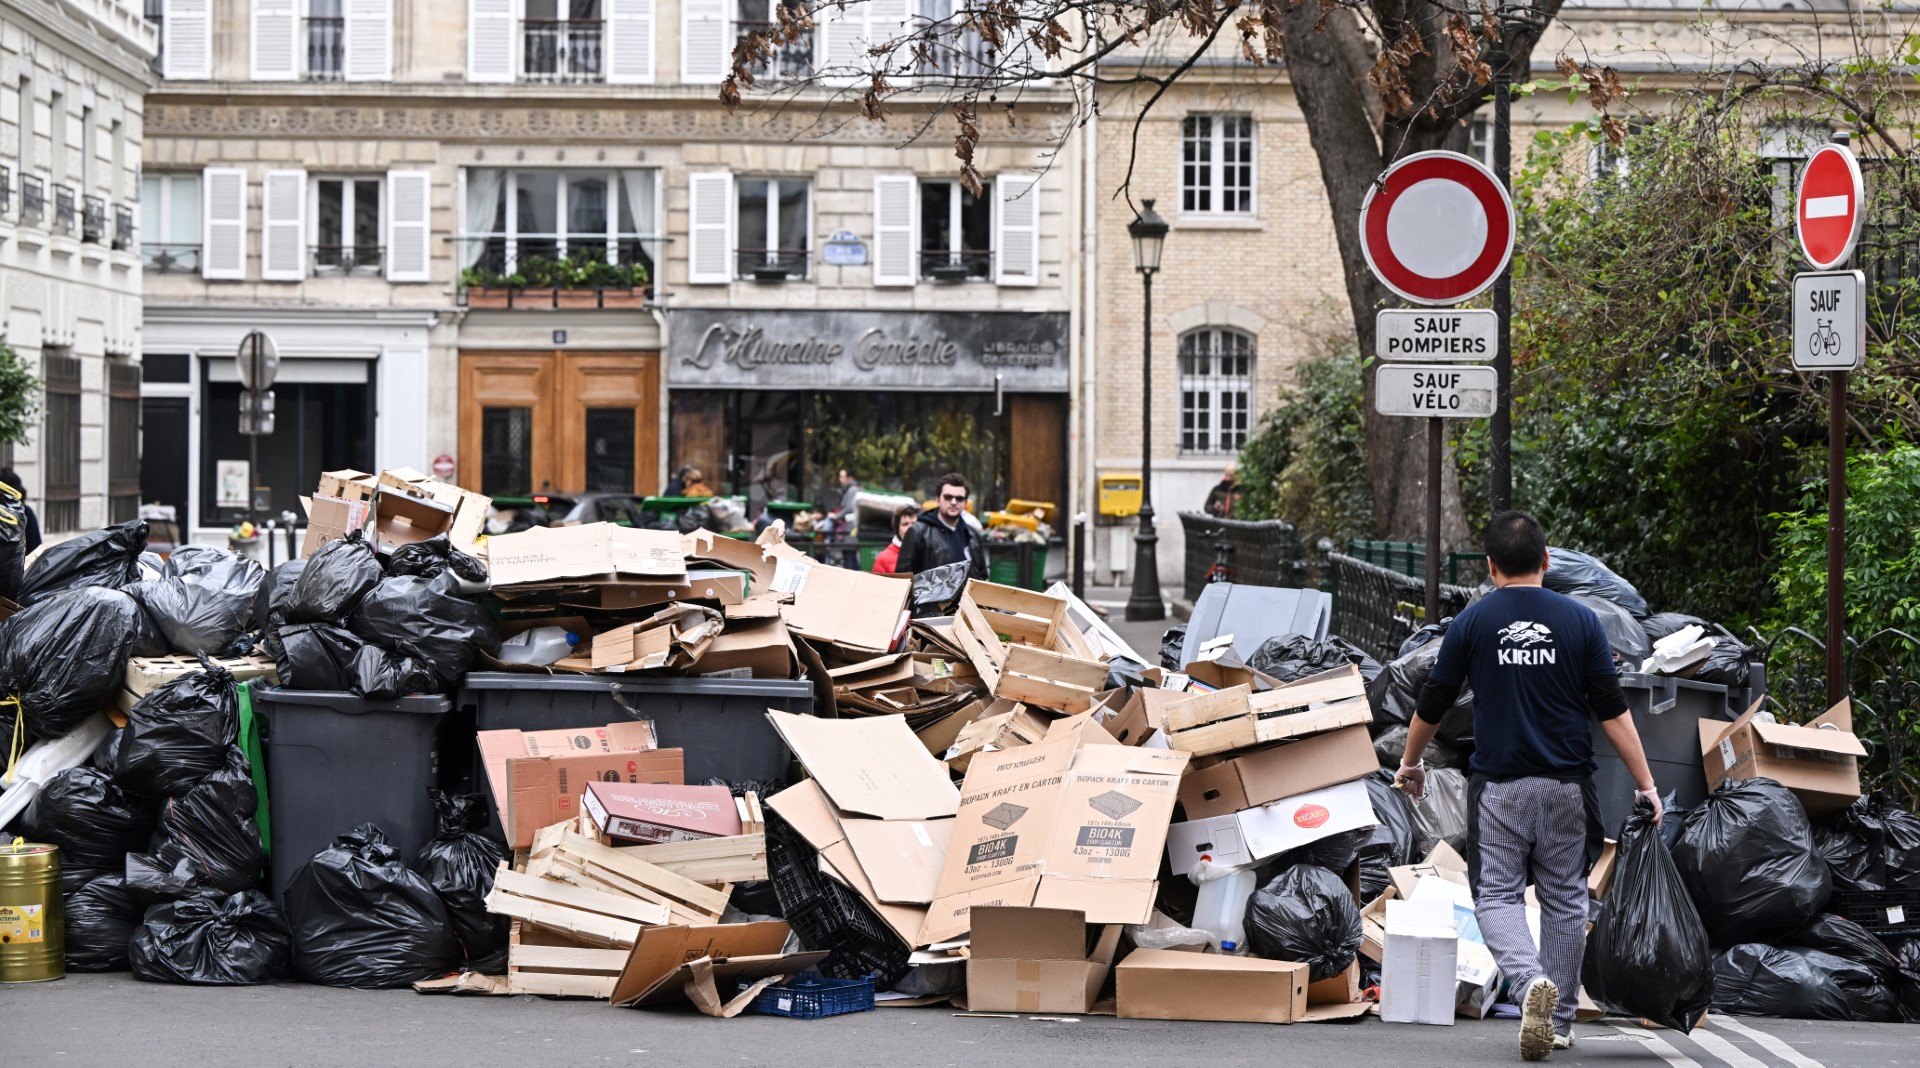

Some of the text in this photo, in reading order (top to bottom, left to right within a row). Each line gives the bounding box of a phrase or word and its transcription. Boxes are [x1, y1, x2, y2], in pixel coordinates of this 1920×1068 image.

[1810, 289, 1841, 312] SAUF
[1414, 317, 1462, 333] SAUF
[681, 322, 958, 371] L'Humaine Comédie
[1388, 337, 1486, 353] POMPIERS
[1413, 372, 1461, 389] SAUF
[1412, 389, 1460, 410] VÉLO
[1497, 648, 1556, 665] KIRIN
[1076, 775, 1105, 783] BIOPACK
[1106, 777, 1130, 785] KRAFT
[1142, 779, 1169, 787] CARTON
[960, 776, 1062, 806] BIOPACK KRAFT EN CARTON
[1296, 809, 1326, 823] BIGARD
[1088, 827, 1123, 840] BIO4K
[977, 838, 1008, 855] BIO4K
[1105, 848, 1131, 858] 1300G
[990, 857, 1014, 869] 1300G
